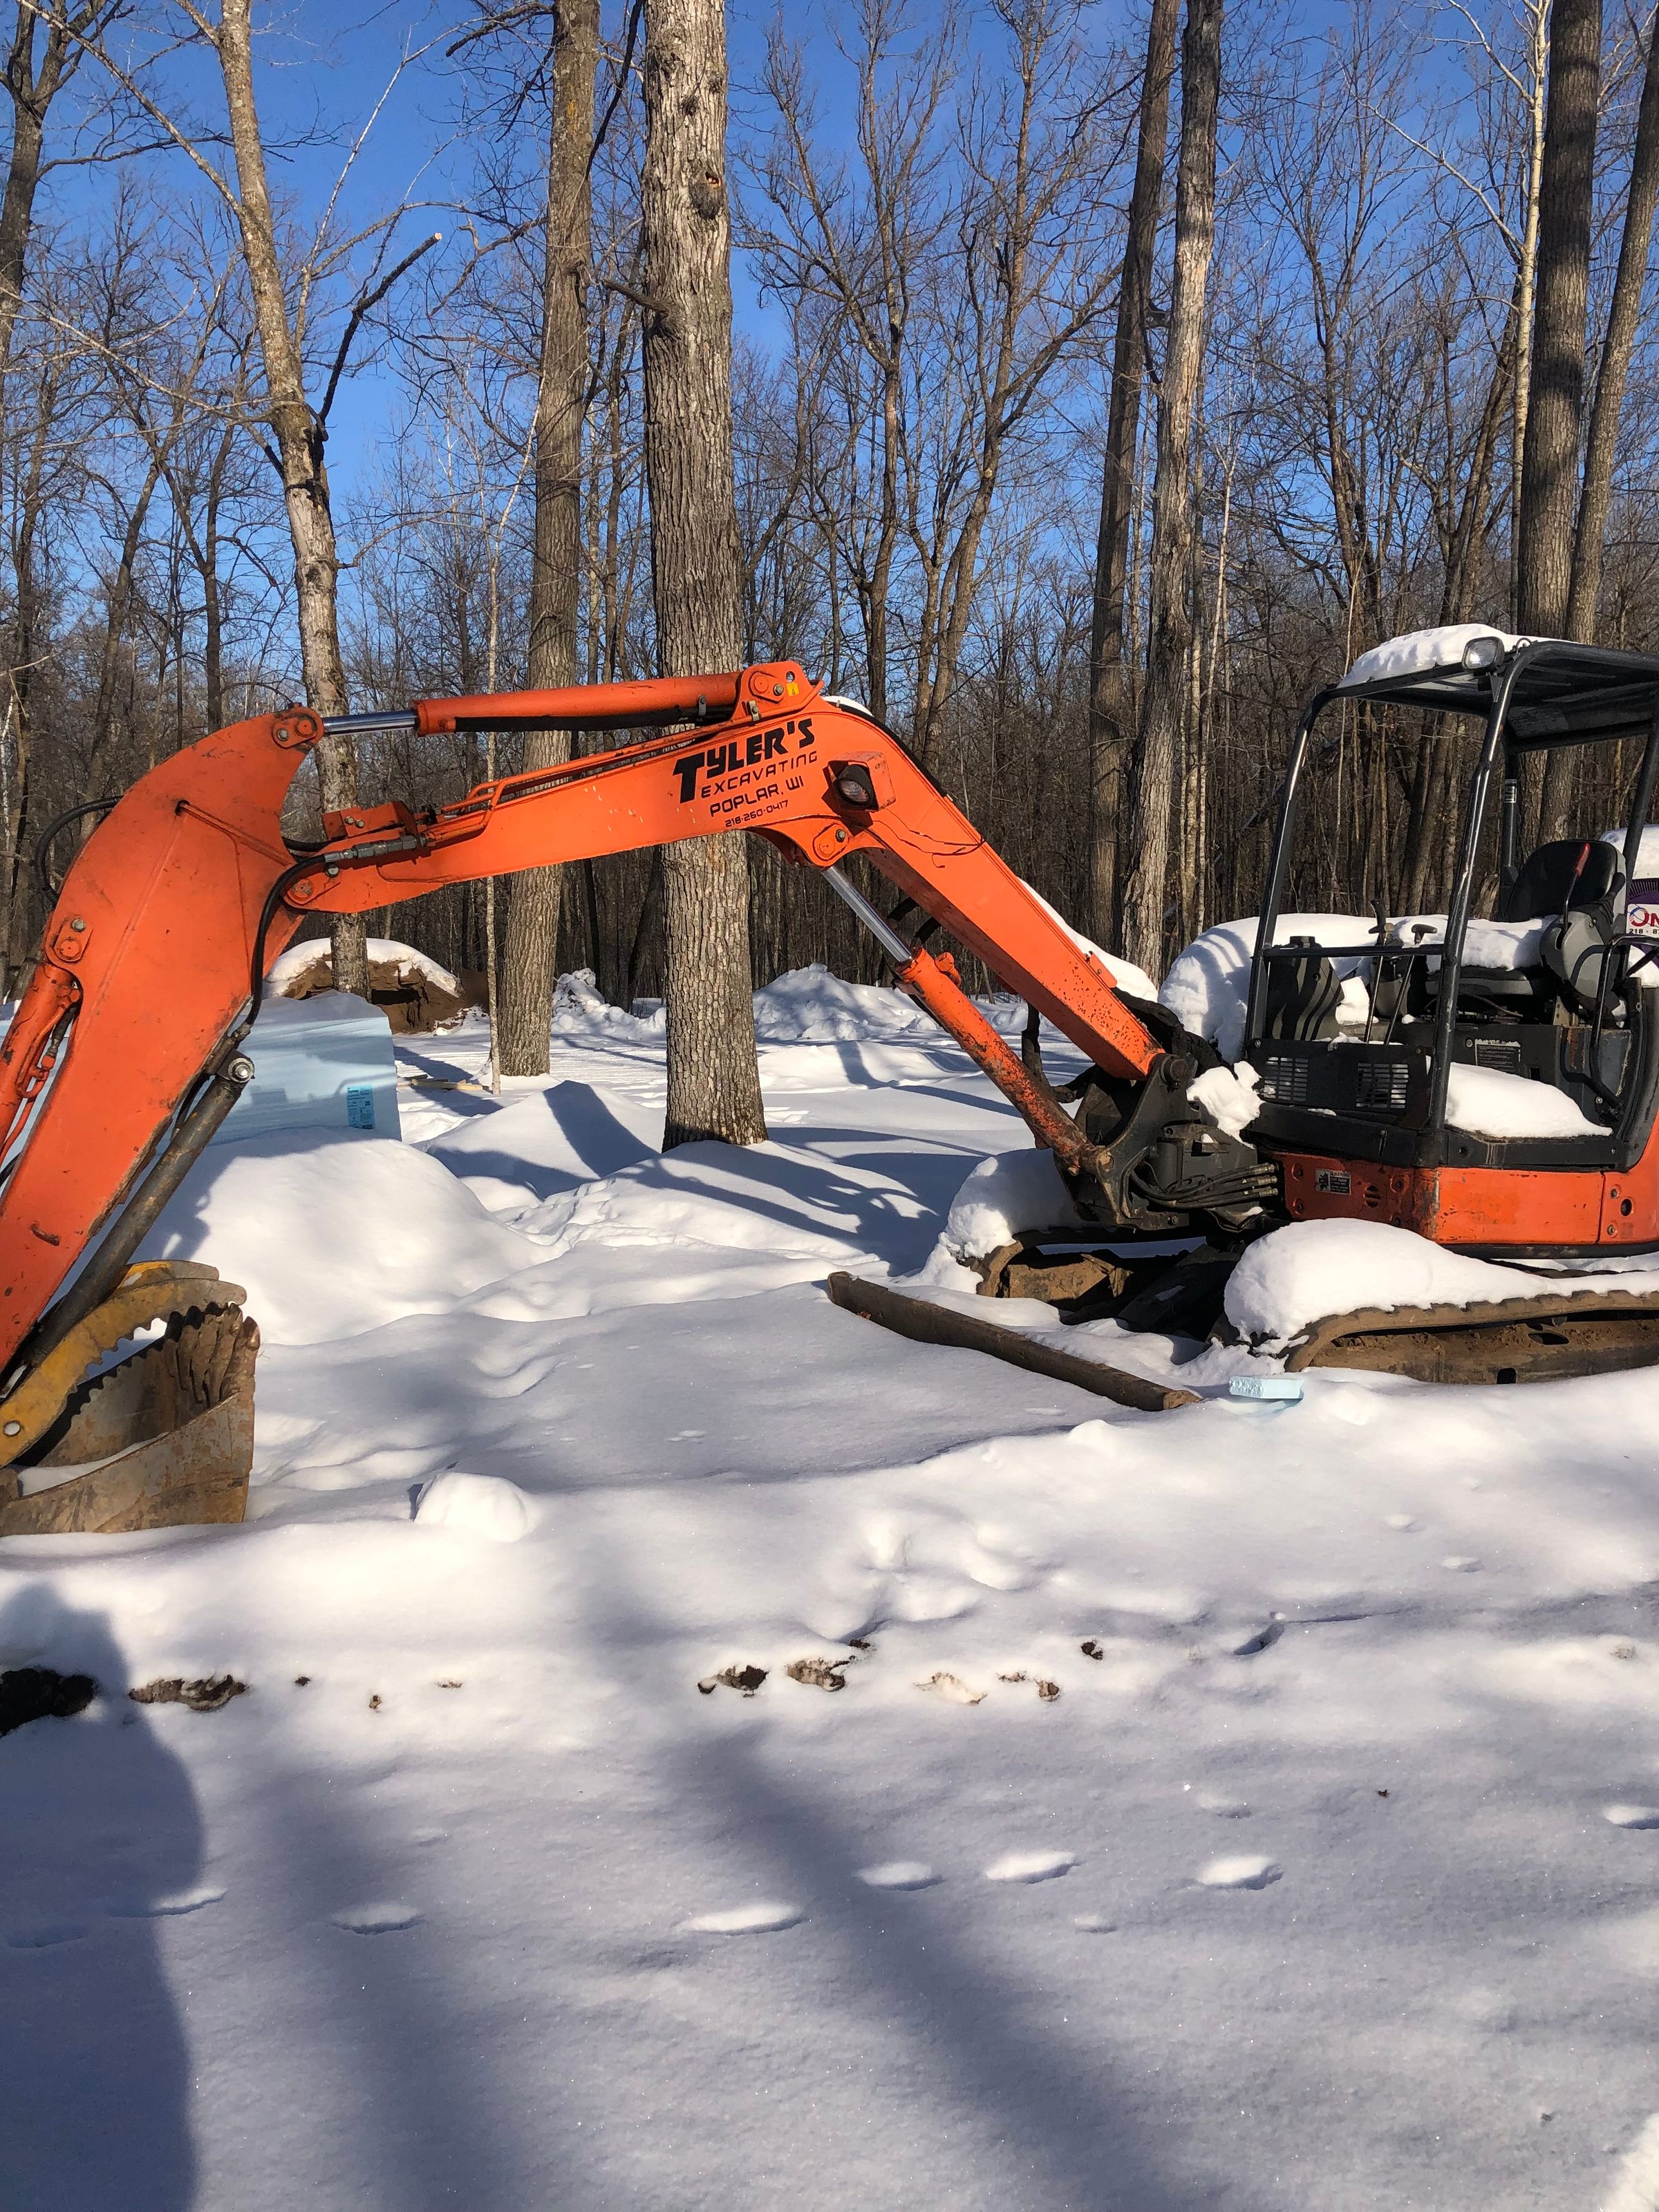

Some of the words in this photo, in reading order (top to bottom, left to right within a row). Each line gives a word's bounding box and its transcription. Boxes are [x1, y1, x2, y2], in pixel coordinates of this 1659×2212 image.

[673, 718, 816, 804] TYLER'S
[701, 751, 818, 798] EXCAVATING
[710, 783, 784, 817] POPLAR,
[785, 775, 804, 791] WI
